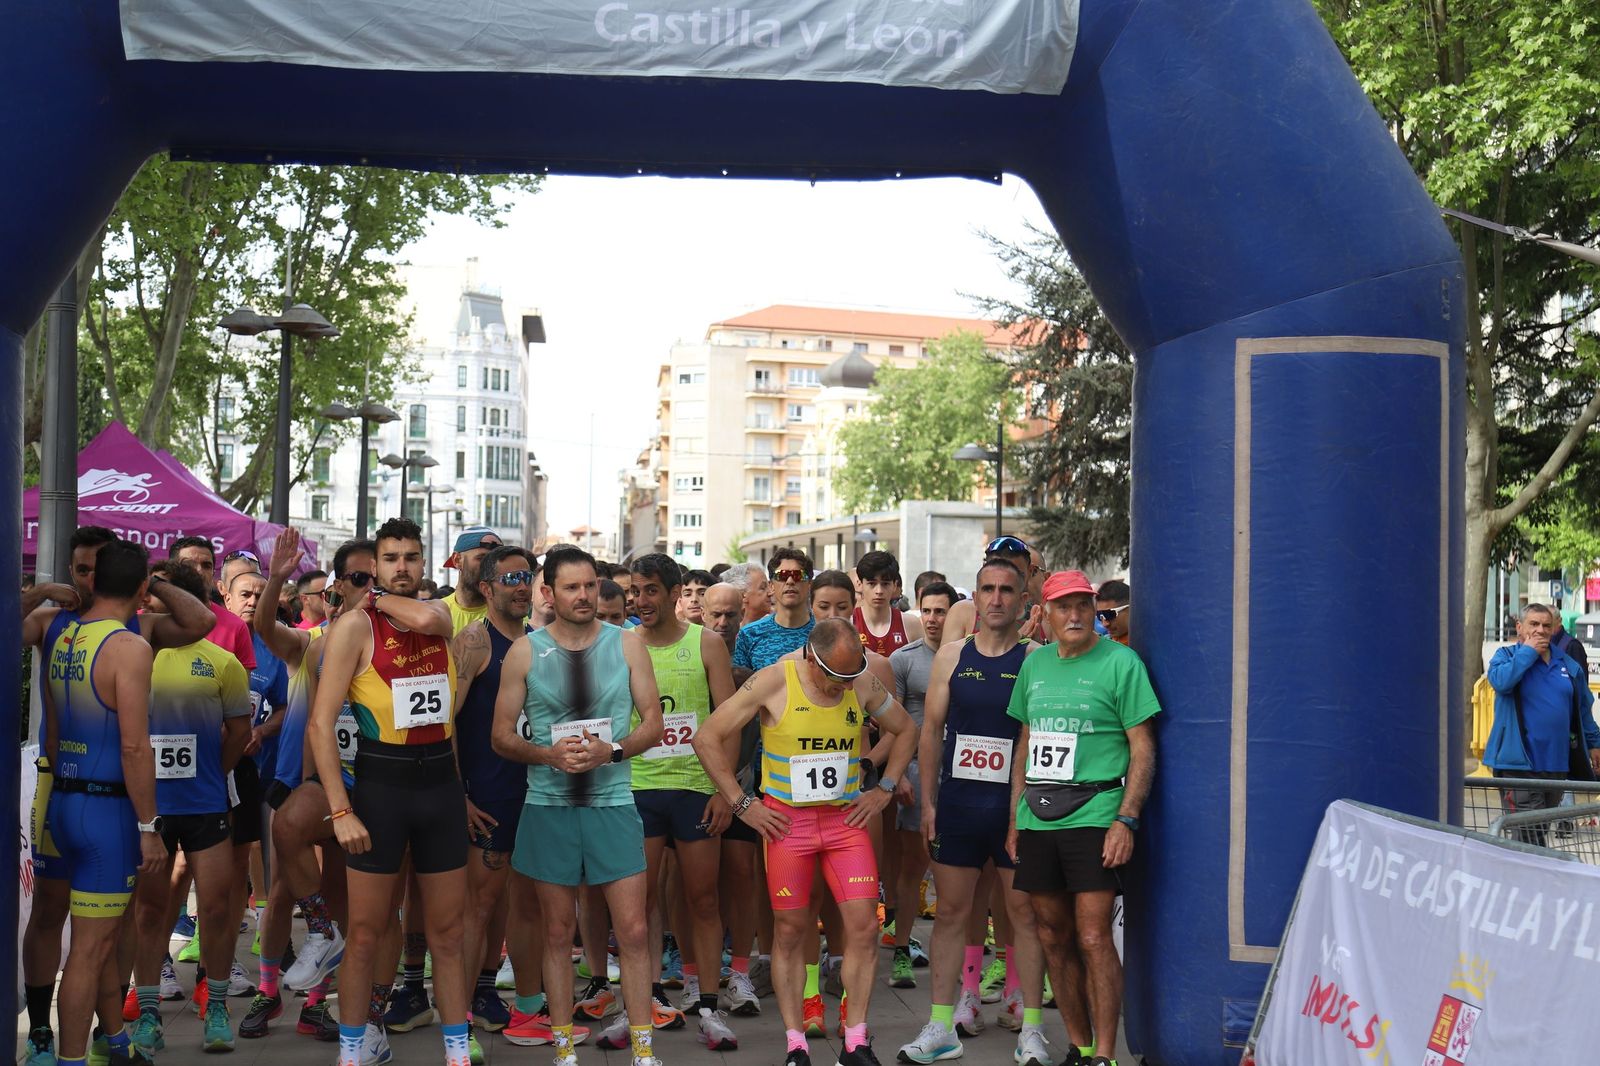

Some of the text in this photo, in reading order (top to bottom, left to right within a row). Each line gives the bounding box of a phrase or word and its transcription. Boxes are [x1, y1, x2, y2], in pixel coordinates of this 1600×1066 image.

[594, 3, 965, 60] Castilla y León
[190, 669, 215, 679] DUERO
[410, 662, 434, 677] VINO
[409, 689, 442, 716] 25
[1029, 717, 1095, 734] AMORA
[798, 737, 855, 751] TEAM
[979, 738, 1009, 747] COMUNIDAD
[958, 748, 1005, 771] 260
[1032, 744, 1071, 769] 157
[806, 766, 838, 790] 18
[1361, 845, 1405, 899] DE
[1404, 860, 1544, 946] CASTILLA
[1549, 897, 1580, 950] Y
[1573, 902, 1600, 964] L
